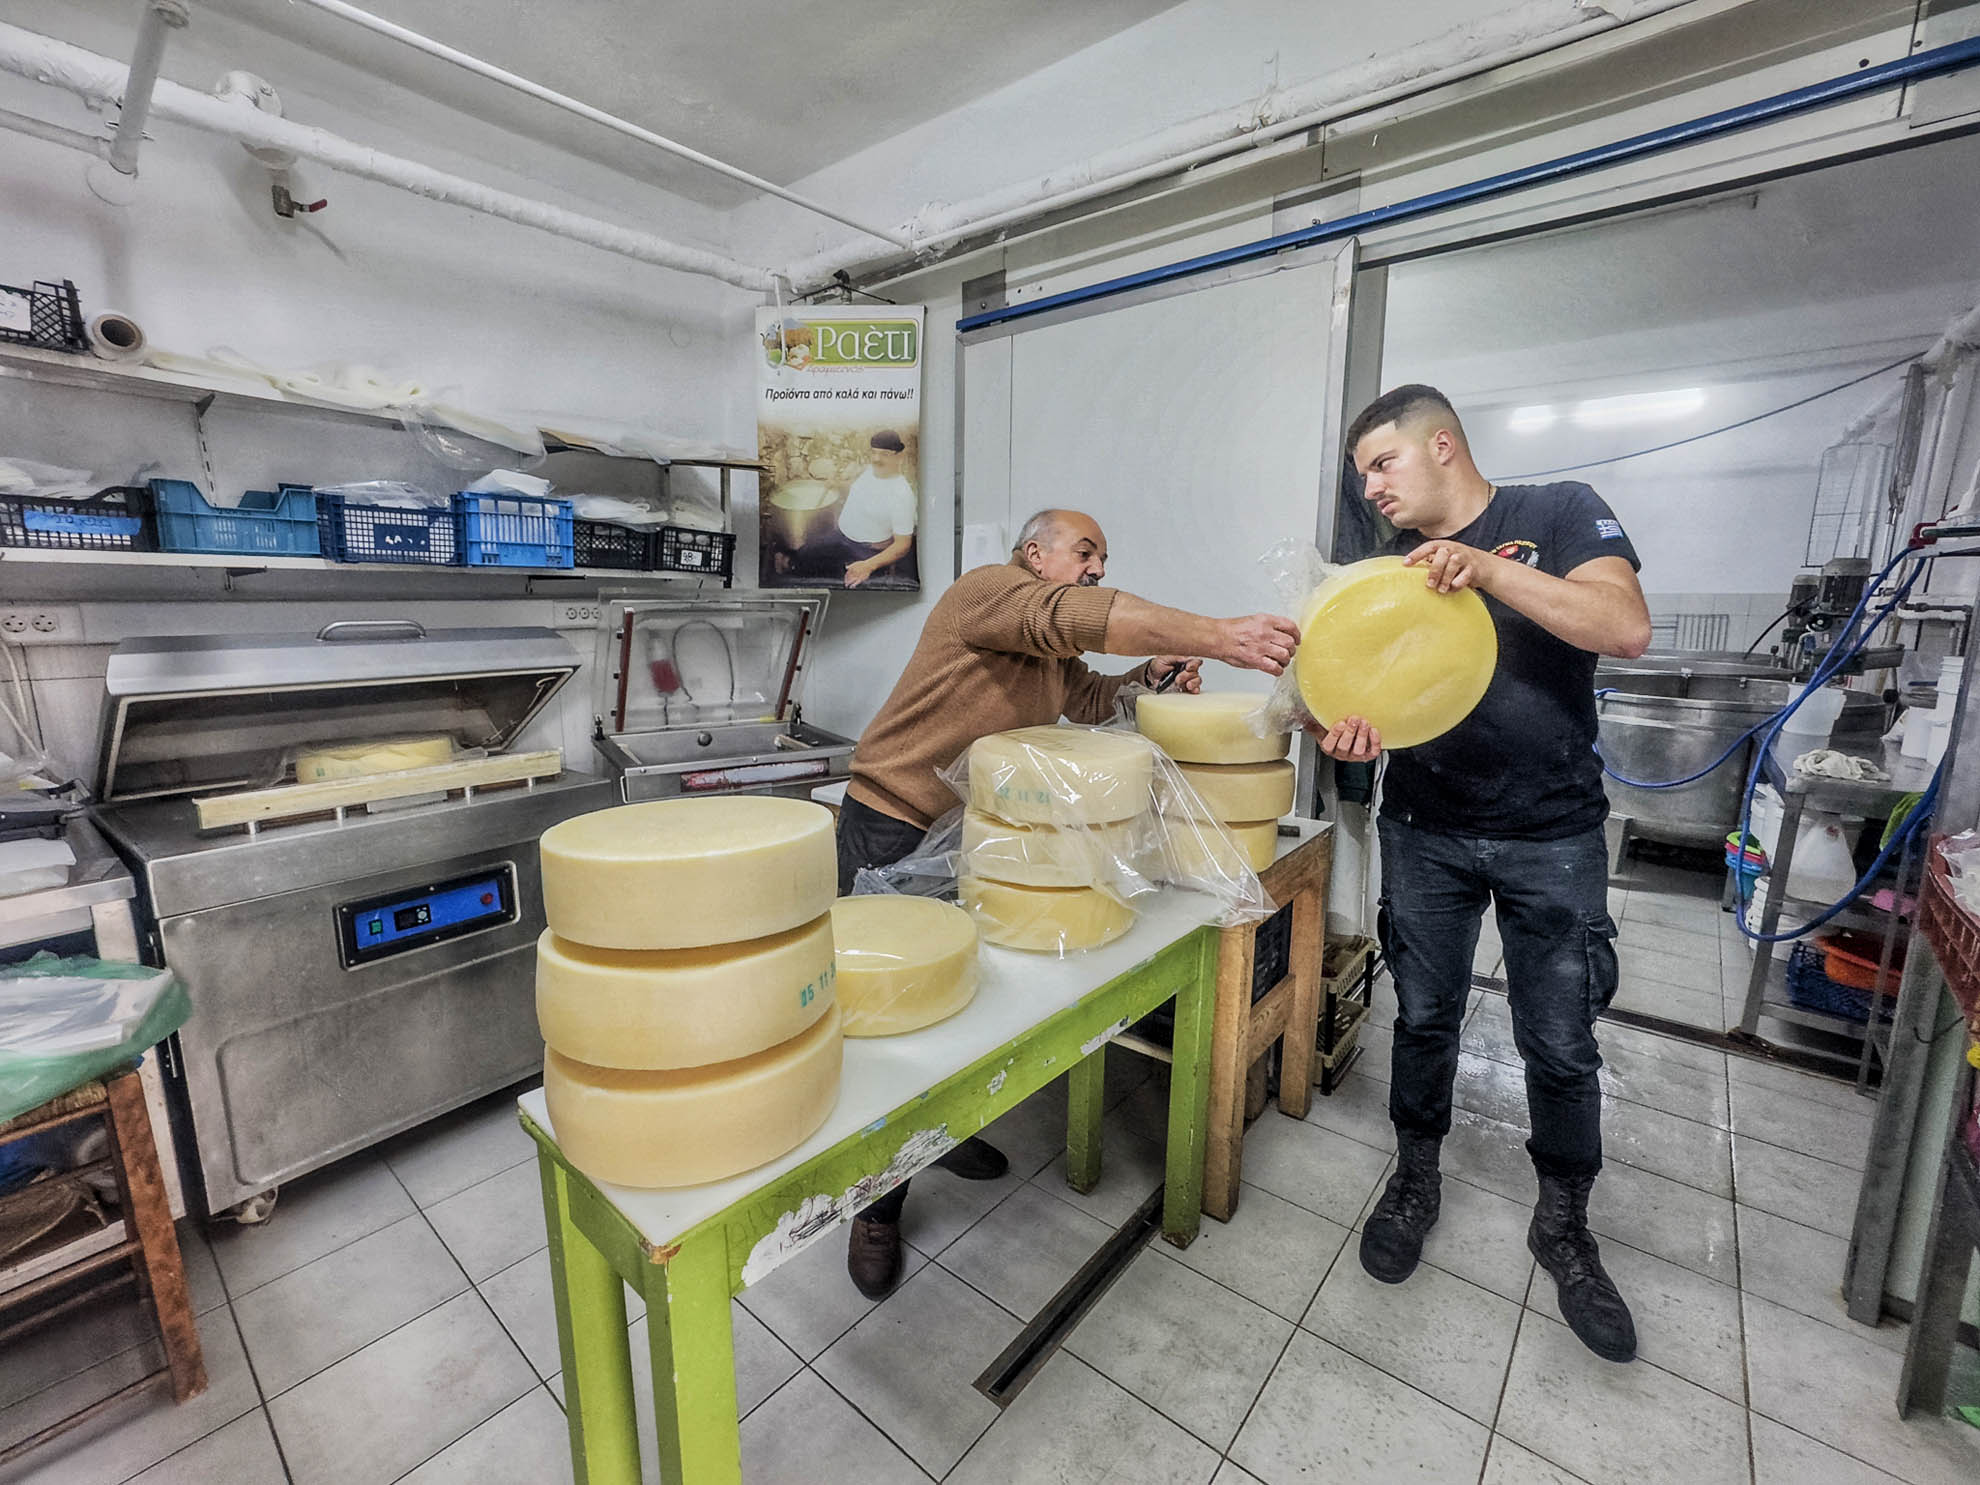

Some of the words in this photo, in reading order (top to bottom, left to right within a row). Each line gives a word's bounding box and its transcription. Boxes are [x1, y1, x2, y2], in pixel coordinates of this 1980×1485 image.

[765, 388, 811, 402] Προϊόντα
[813, 388, 833, 400] από
[836, 388, 859, 400] καλά
[862, 390, 877, 400] και
[880, 388, 914, 400] πάνω!!
